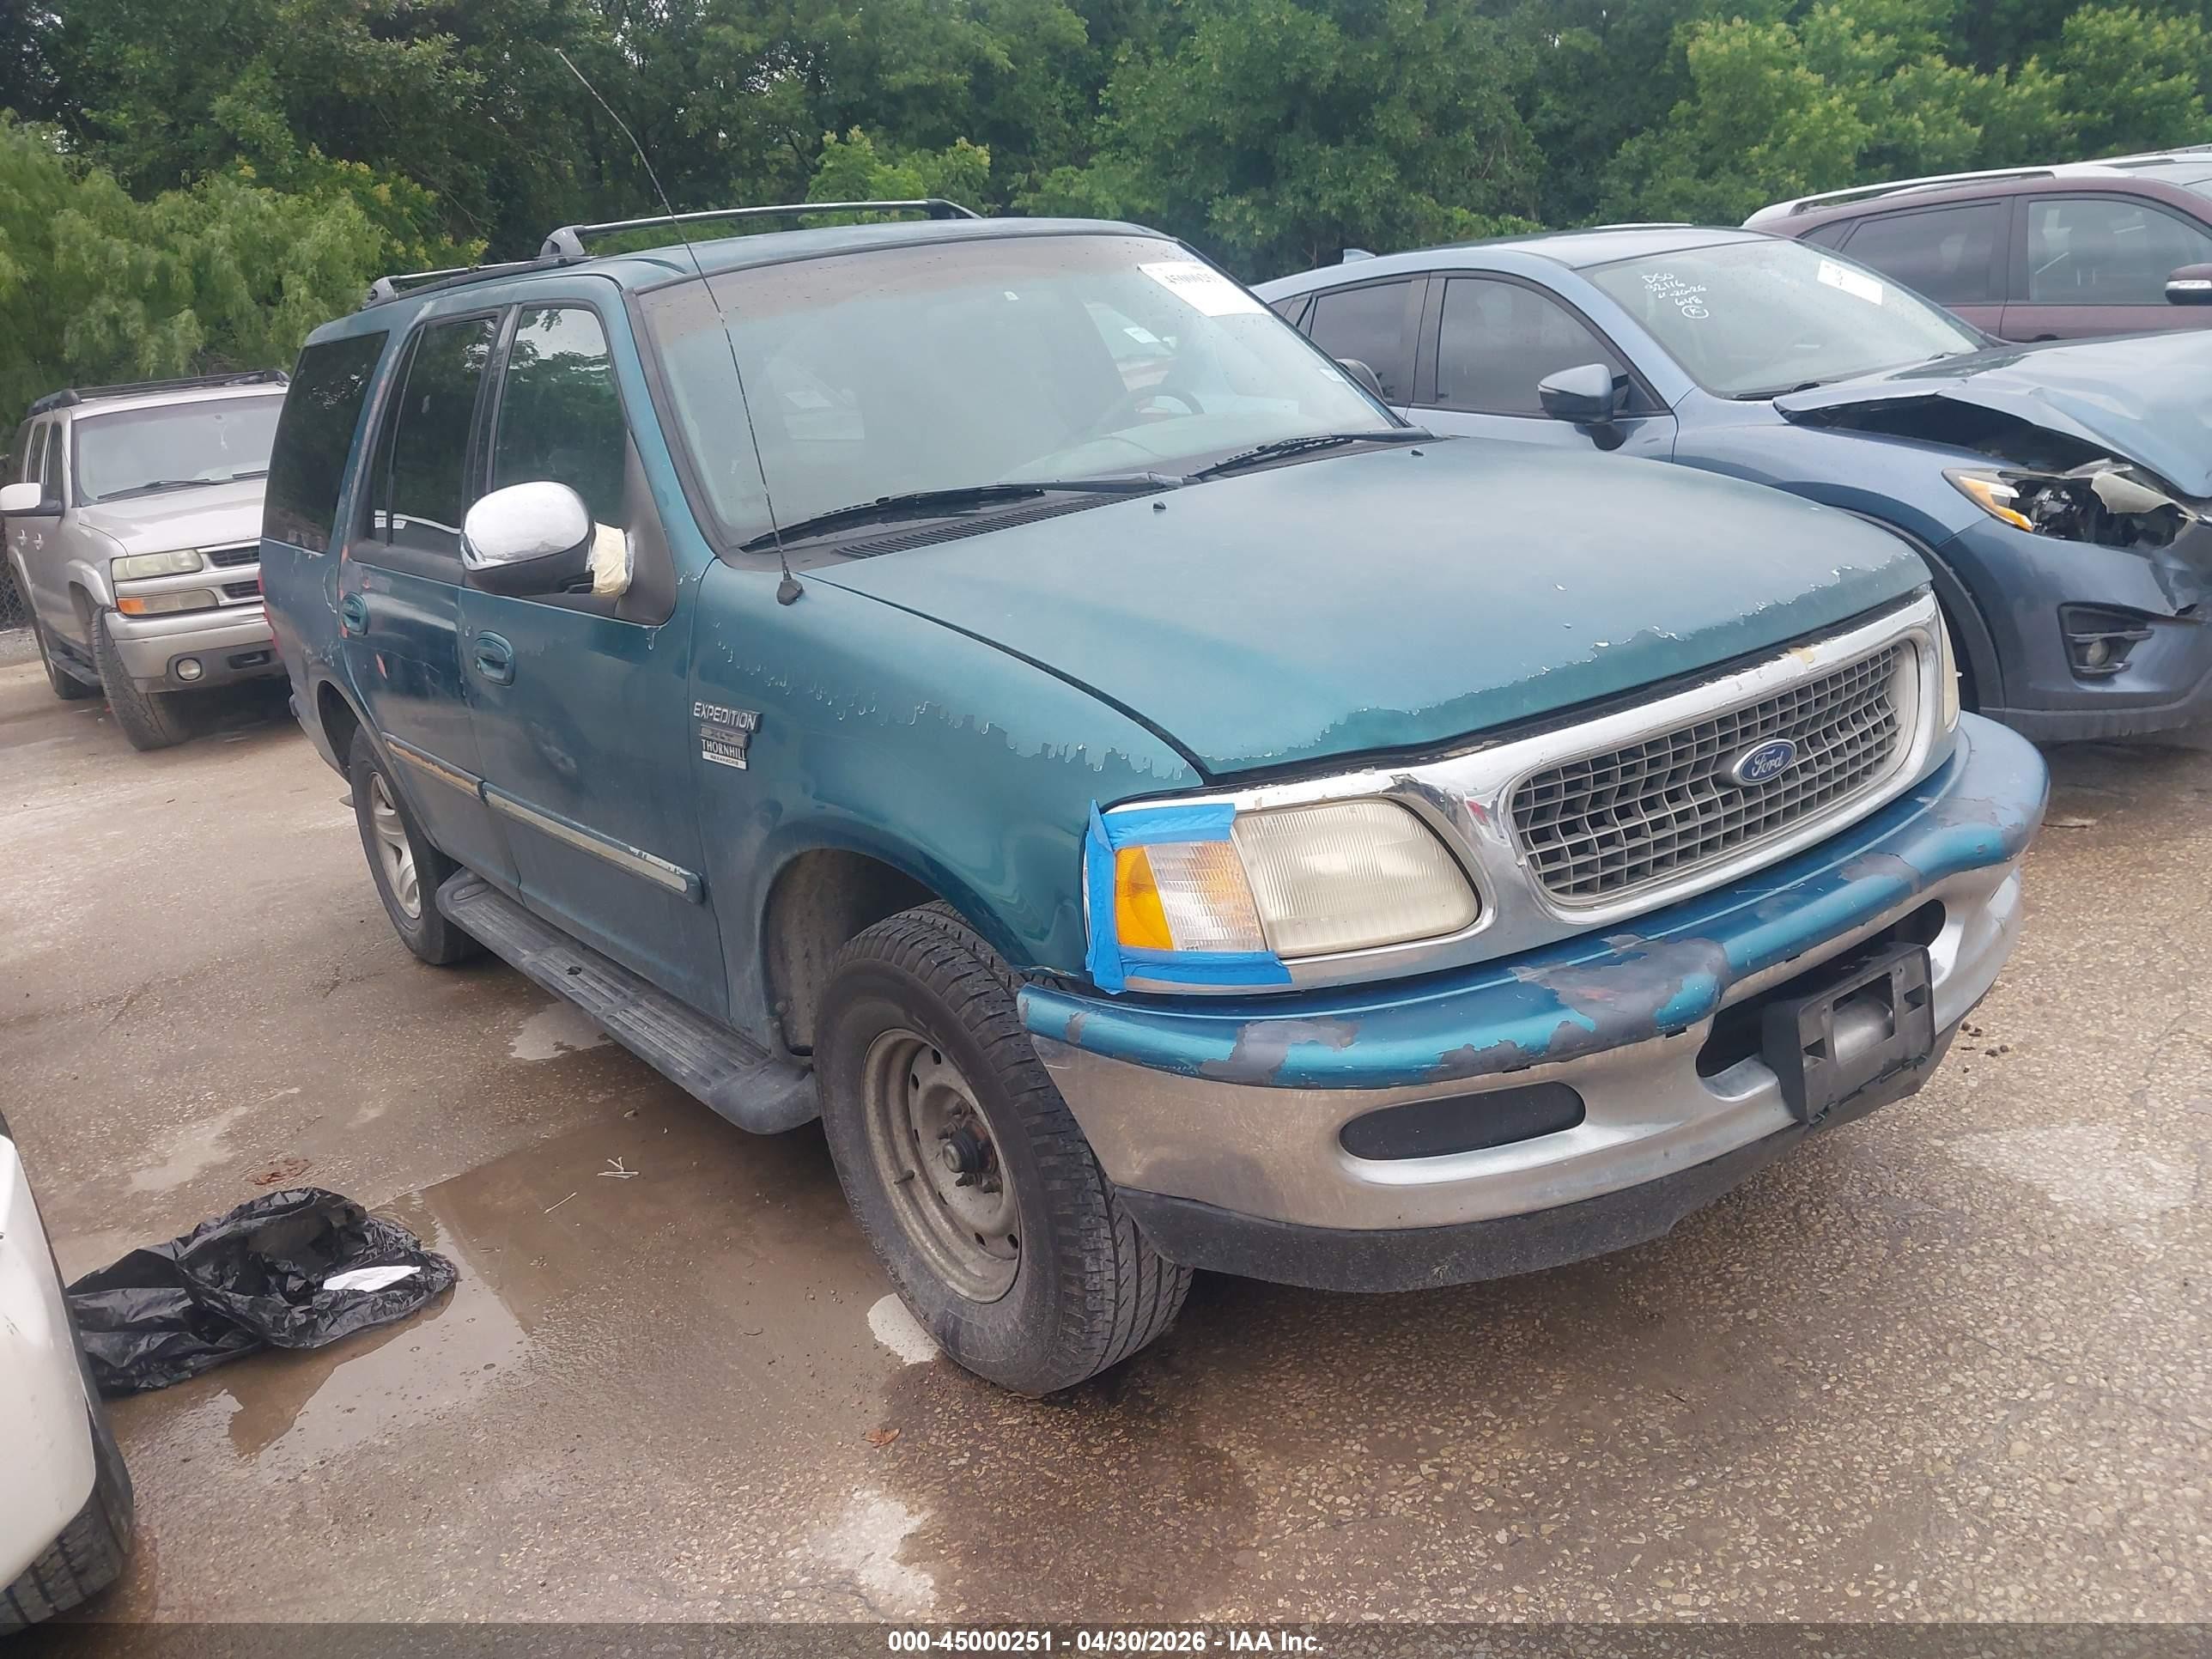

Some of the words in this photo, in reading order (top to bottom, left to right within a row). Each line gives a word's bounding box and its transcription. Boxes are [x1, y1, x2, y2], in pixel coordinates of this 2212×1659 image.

[693, 702, 757, 730] EXPEDITION
[701, 738, 747, 761] THORNHILL
[1752, 749, 1784, 777] Ford
